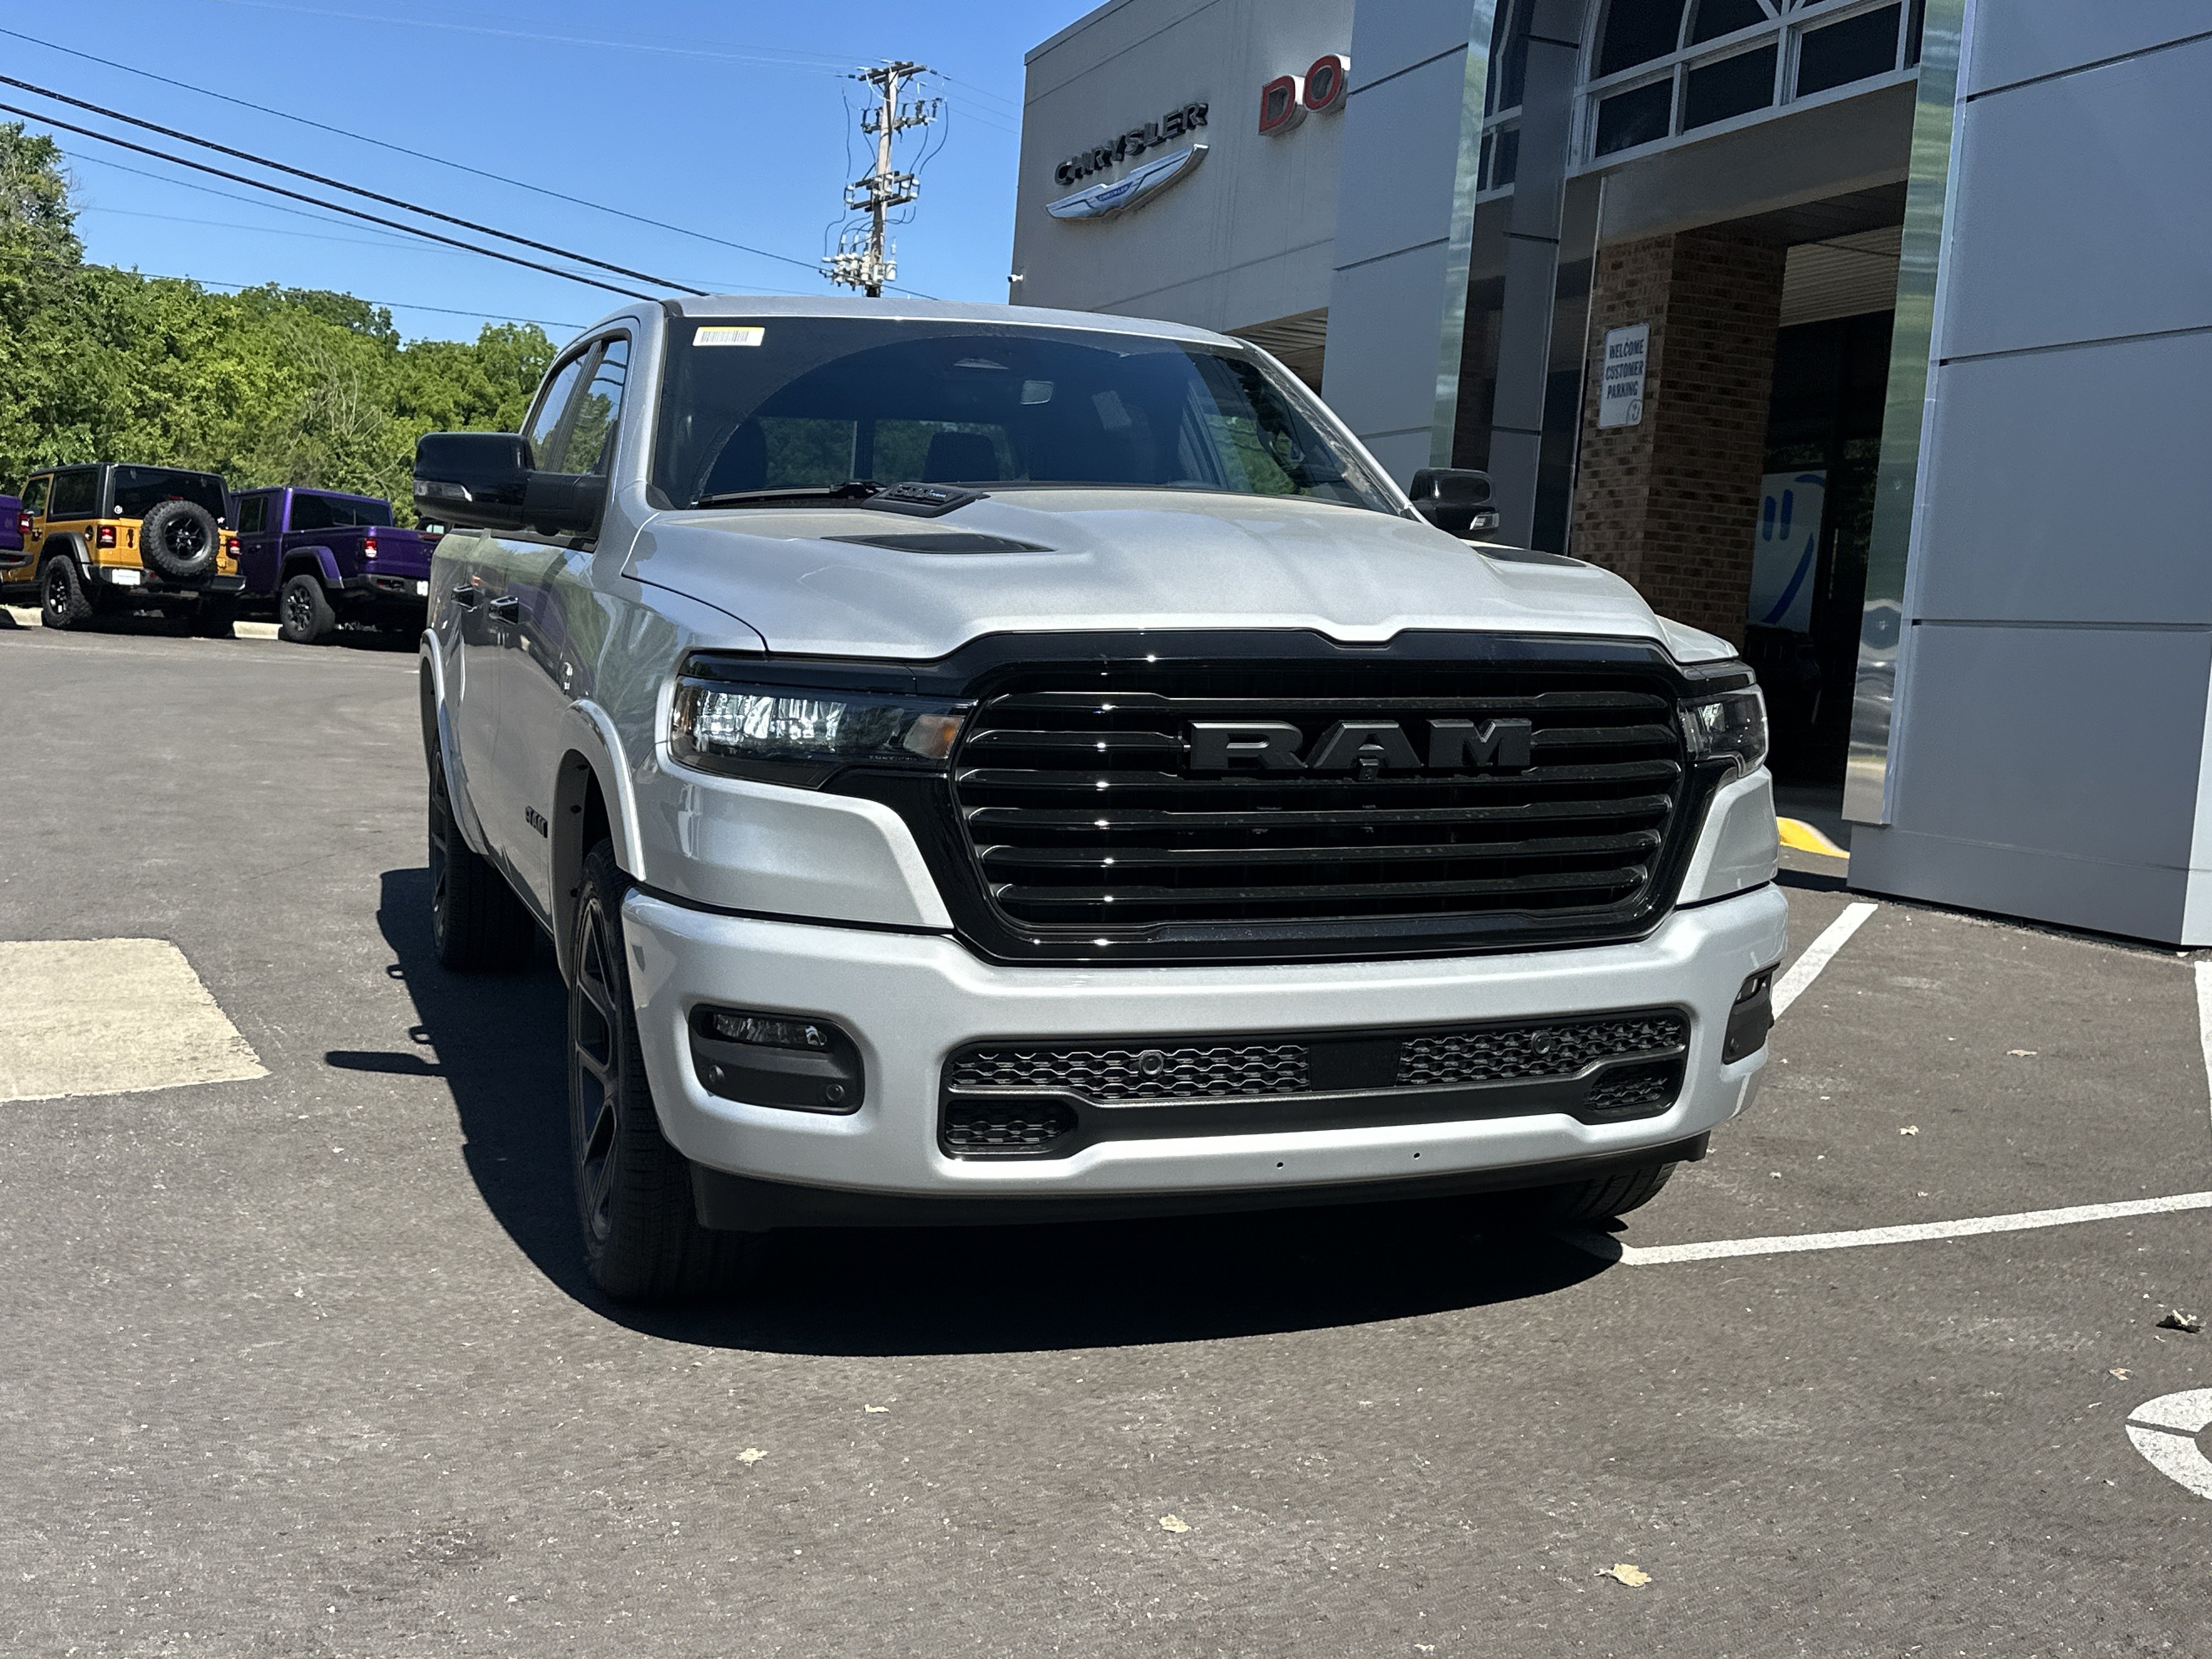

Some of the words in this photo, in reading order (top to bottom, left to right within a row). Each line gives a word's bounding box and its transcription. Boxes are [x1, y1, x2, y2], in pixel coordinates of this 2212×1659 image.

[1054, 101, 1208, 185] CHRYSLER
[1609, 338, 1645, 359] WELCOME
[1607, 381, 1639, 400] PARKING
[1188, 719, 1533, 768] RAM
[525, 805, 548, 839] RAM
